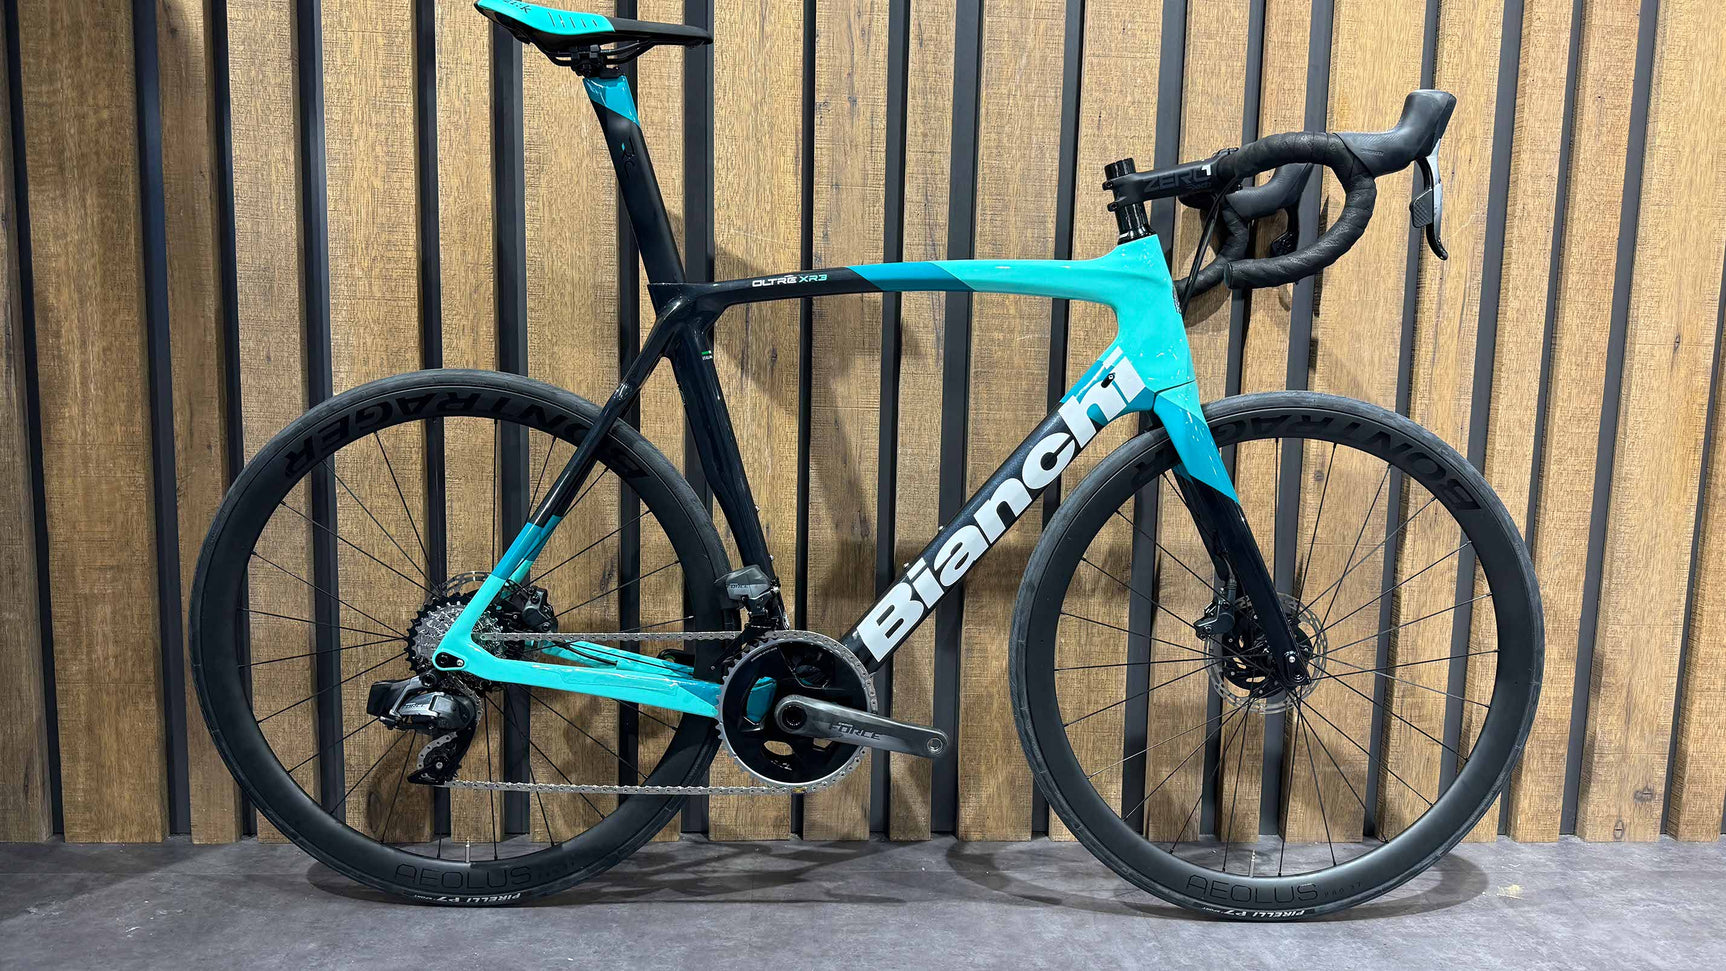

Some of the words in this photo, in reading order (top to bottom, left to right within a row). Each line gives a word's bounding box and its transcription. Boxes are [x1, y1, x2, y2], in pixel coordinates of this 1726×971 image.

[752, 275, 797, 288] OLTRE
[798, 274, 828, 283] XR3
[1131, 415, 1483, 512] BONTRAGR
[856, 345, 1146, 663] Bianchi
[829, 723, 881, 741] FORCE
[394, 863, 532, 889] AEOLUS
[466, 892, 521, 903] PIRELLI
[1186, 874, 1319, 904] AEOLUS
[1223, 909, 1247, 917] P7
[1252, 910, 1305, 918] PIRELLI
